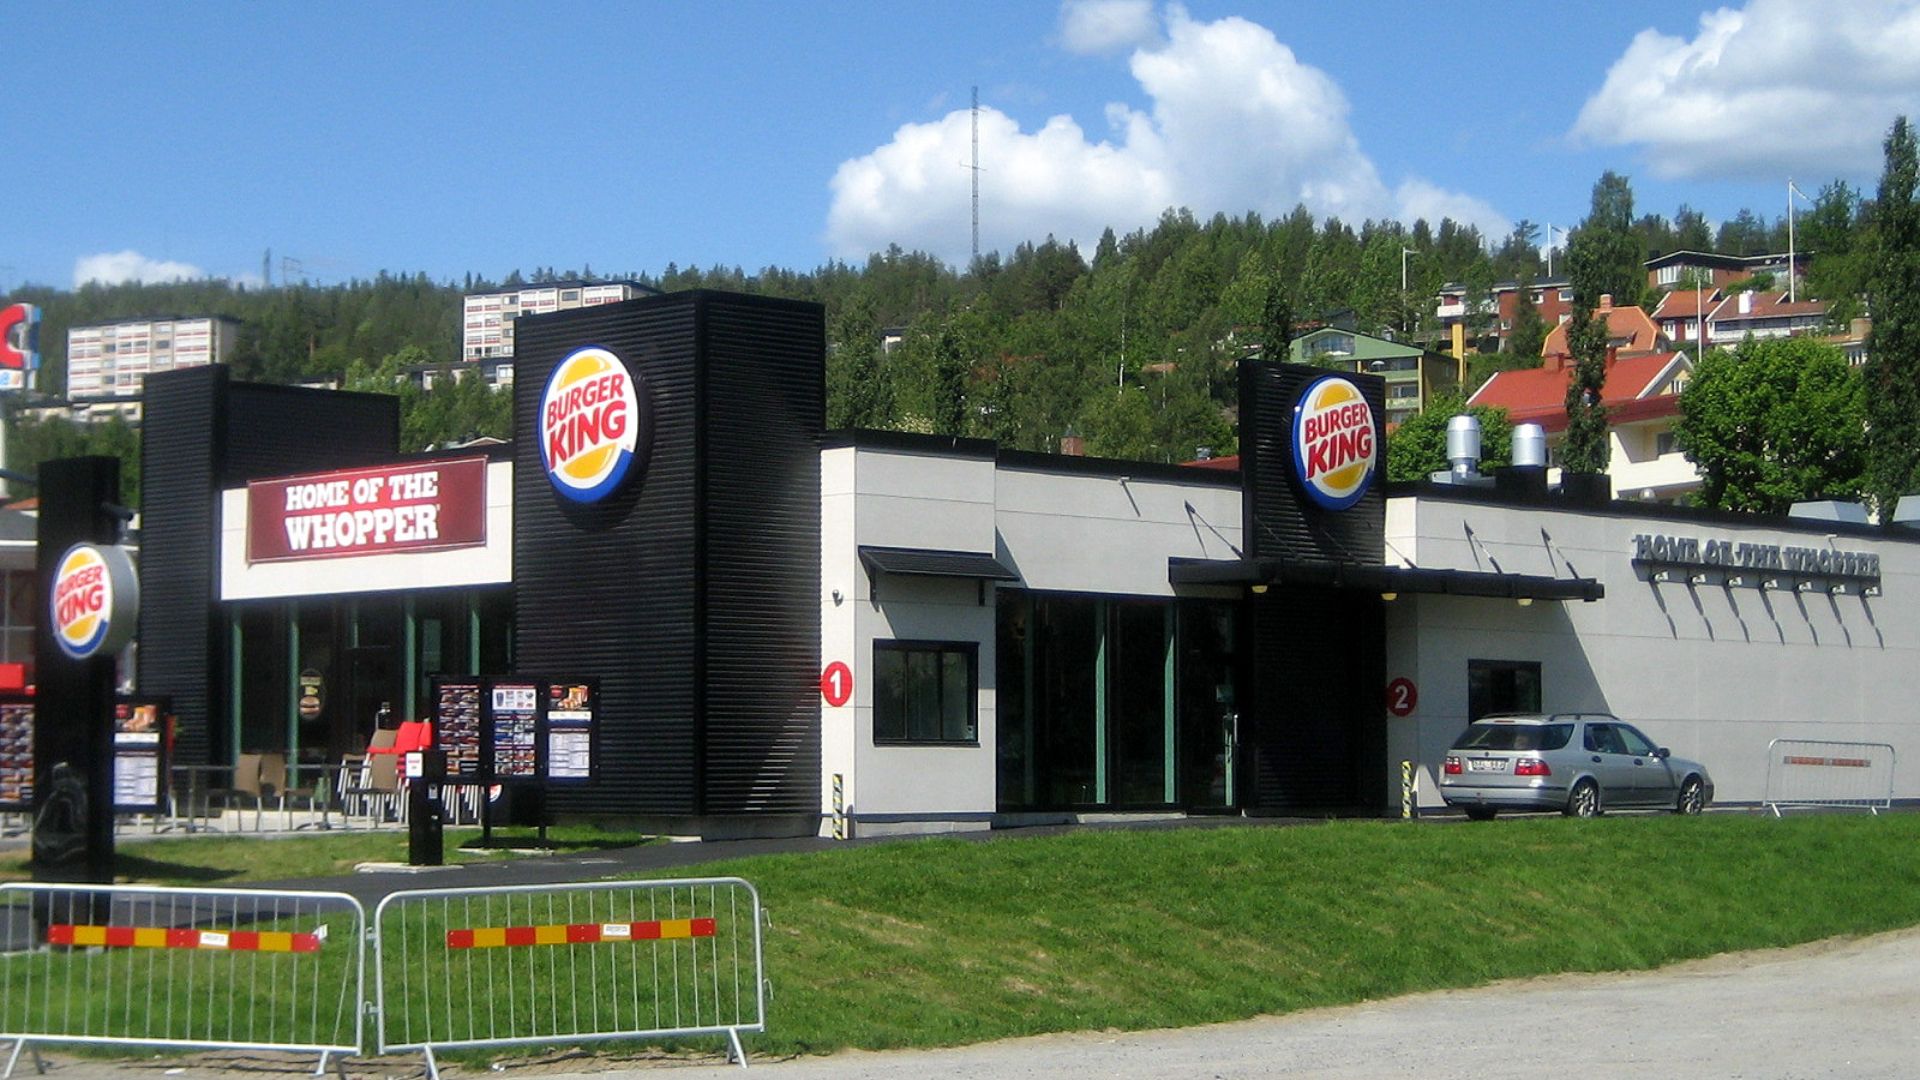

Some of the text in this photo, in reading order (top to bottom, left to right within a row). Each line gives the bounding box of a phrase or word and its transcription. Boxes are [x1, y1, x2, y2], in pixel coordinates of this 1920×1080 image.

[547, 373, 625, 431] BURGER
[1305, 402, 1369, 444] BURGER
[549, 400, 626, 470] KING
[1307, 425, 1371, 479] KING
[285, 471, 439, 512] HOME OF THE
[284, 503, 439, 551] WHOPPER
[1631, 534, 1880, 577] HOME OF THE WHOPPER
[57, 584, 104, 627] KING
[829, 669, 841, 699] 1
[1394, 684, 1409, 709] 2
